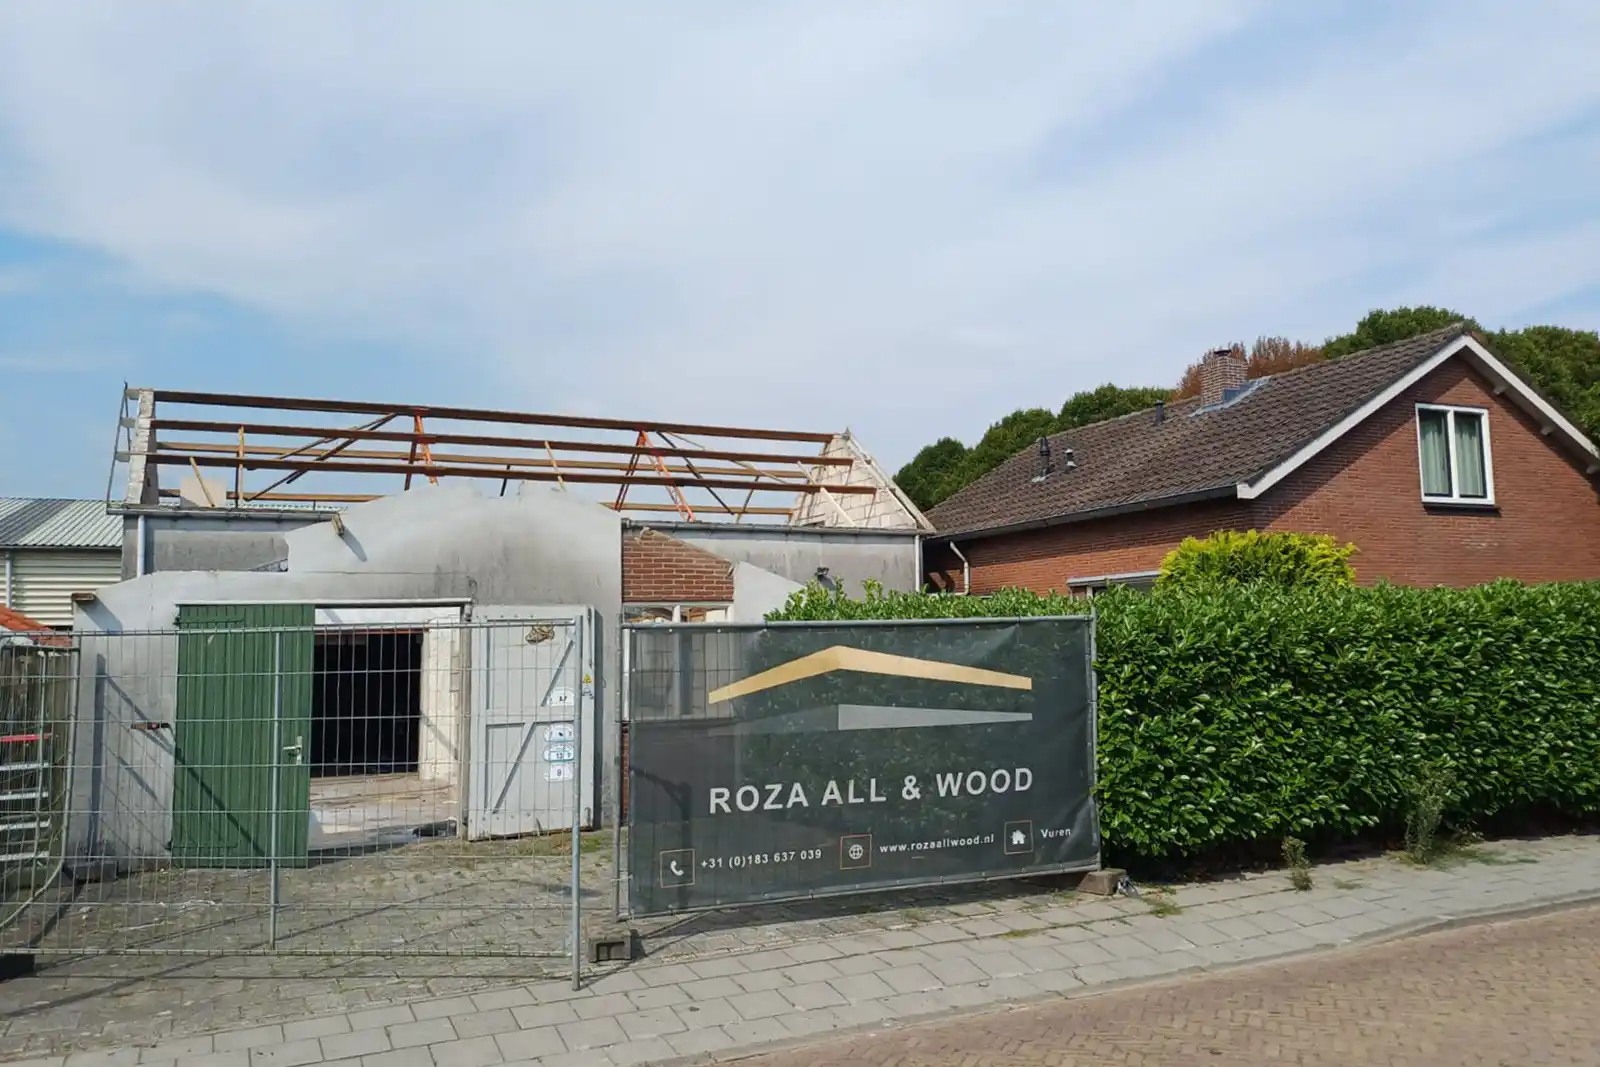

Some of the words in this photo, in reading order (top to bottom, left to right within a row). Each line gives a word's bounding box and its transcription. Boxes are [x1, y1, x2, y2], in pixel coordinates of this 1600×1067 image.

[709, 782, 809, 815] ROZA
[821, 777, 887, 806] ALL
[901, 775, 921, 801] &
[936, 767, 1034, 797] WOOD
[879, 833, 995, 853] www.rozaallwood.nl
[1040, 828, 1072, 839] Vuren
[700, 857, 723, 870] +31
[728, 853, 769, 870] (0)183
[773, 851, 796, 863] 637
[800, 848, 823, 861] 039
